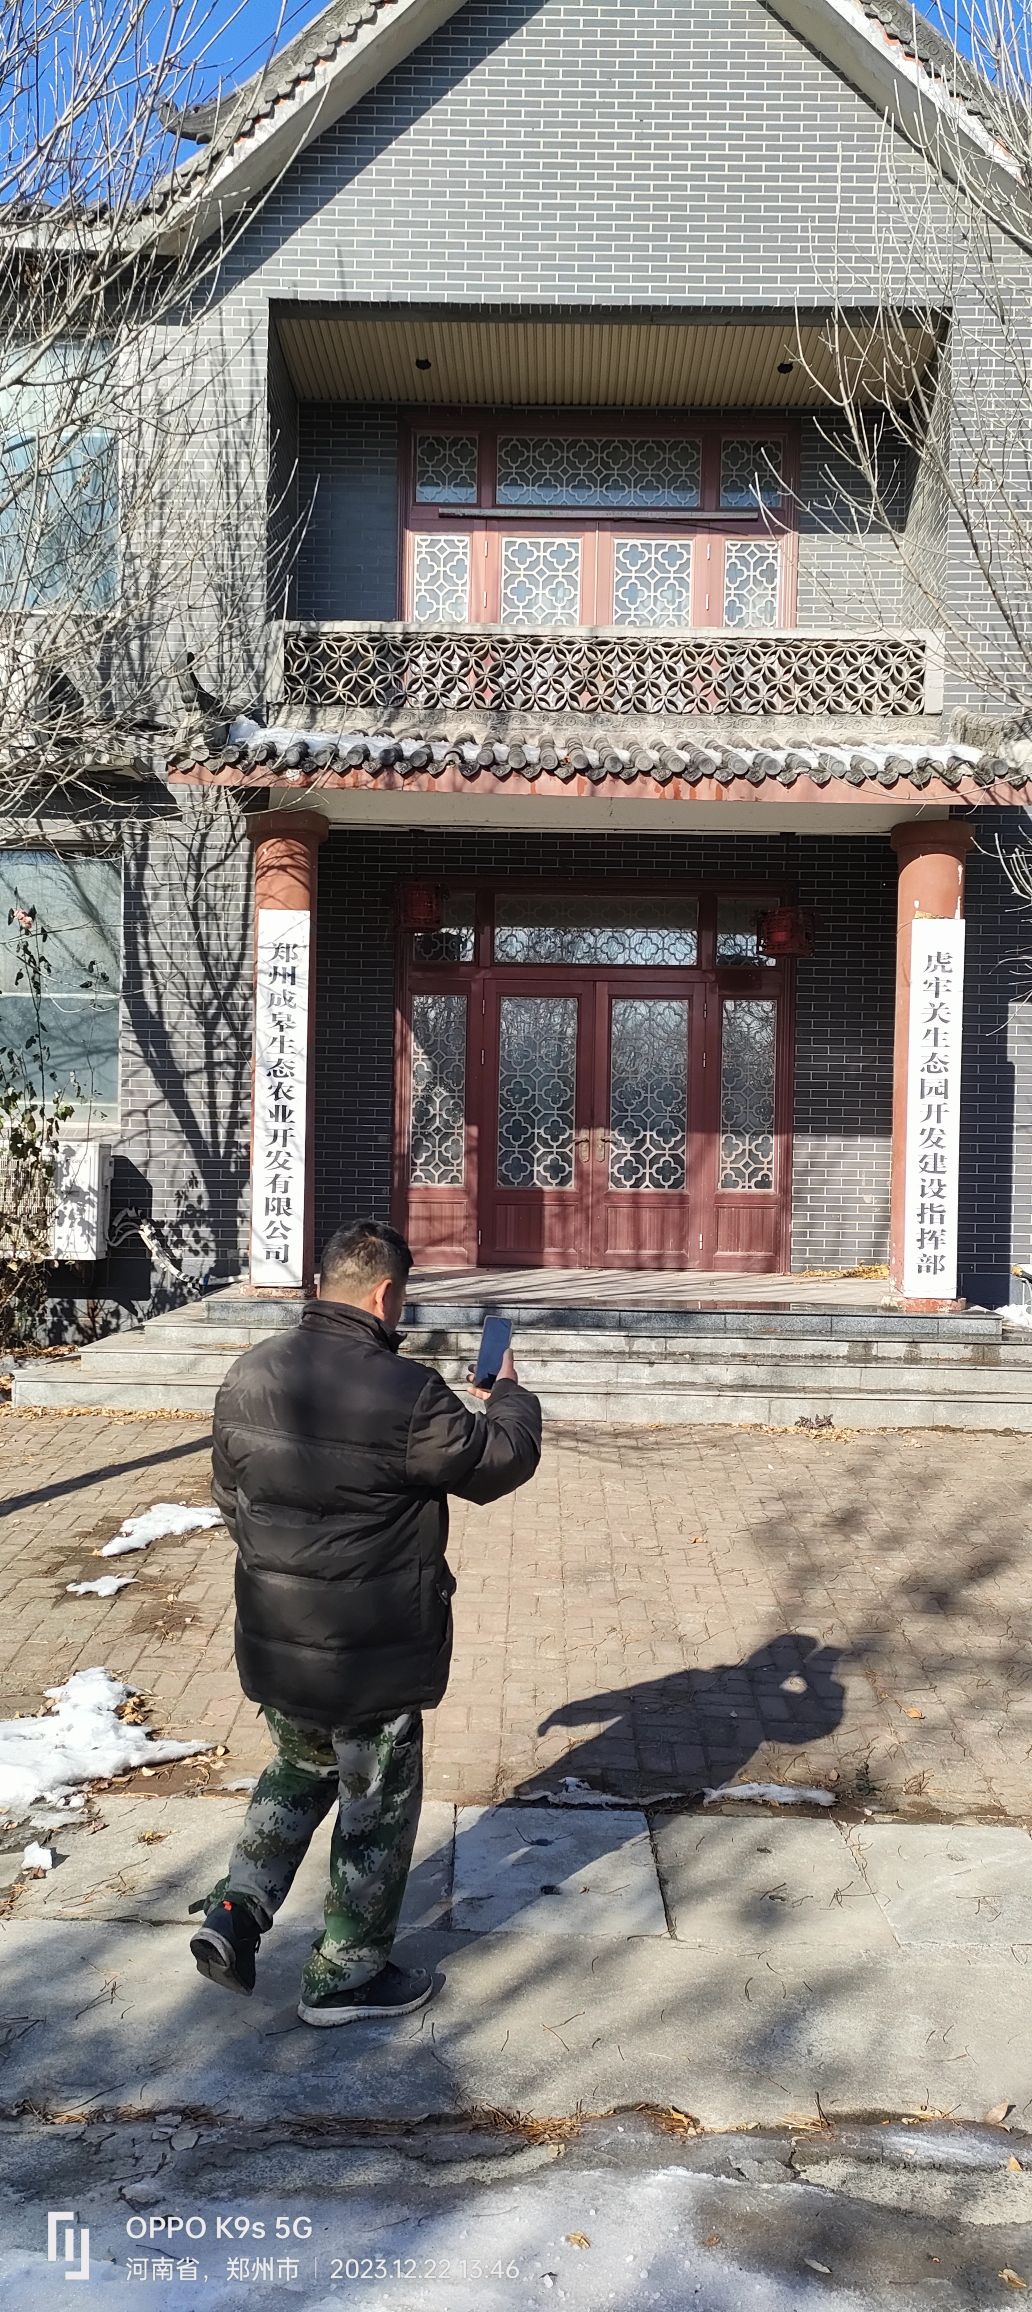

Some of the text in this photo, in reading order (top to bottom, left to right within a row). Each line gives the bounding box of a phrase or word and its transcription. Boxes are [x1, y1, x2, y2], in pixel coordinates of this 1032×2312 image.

[263, 942, 299, 1264] 郑州成皋生态农业开发有限公司
[916, 951, 953, 1275] 虎牢关生态园开发建设指挥部
